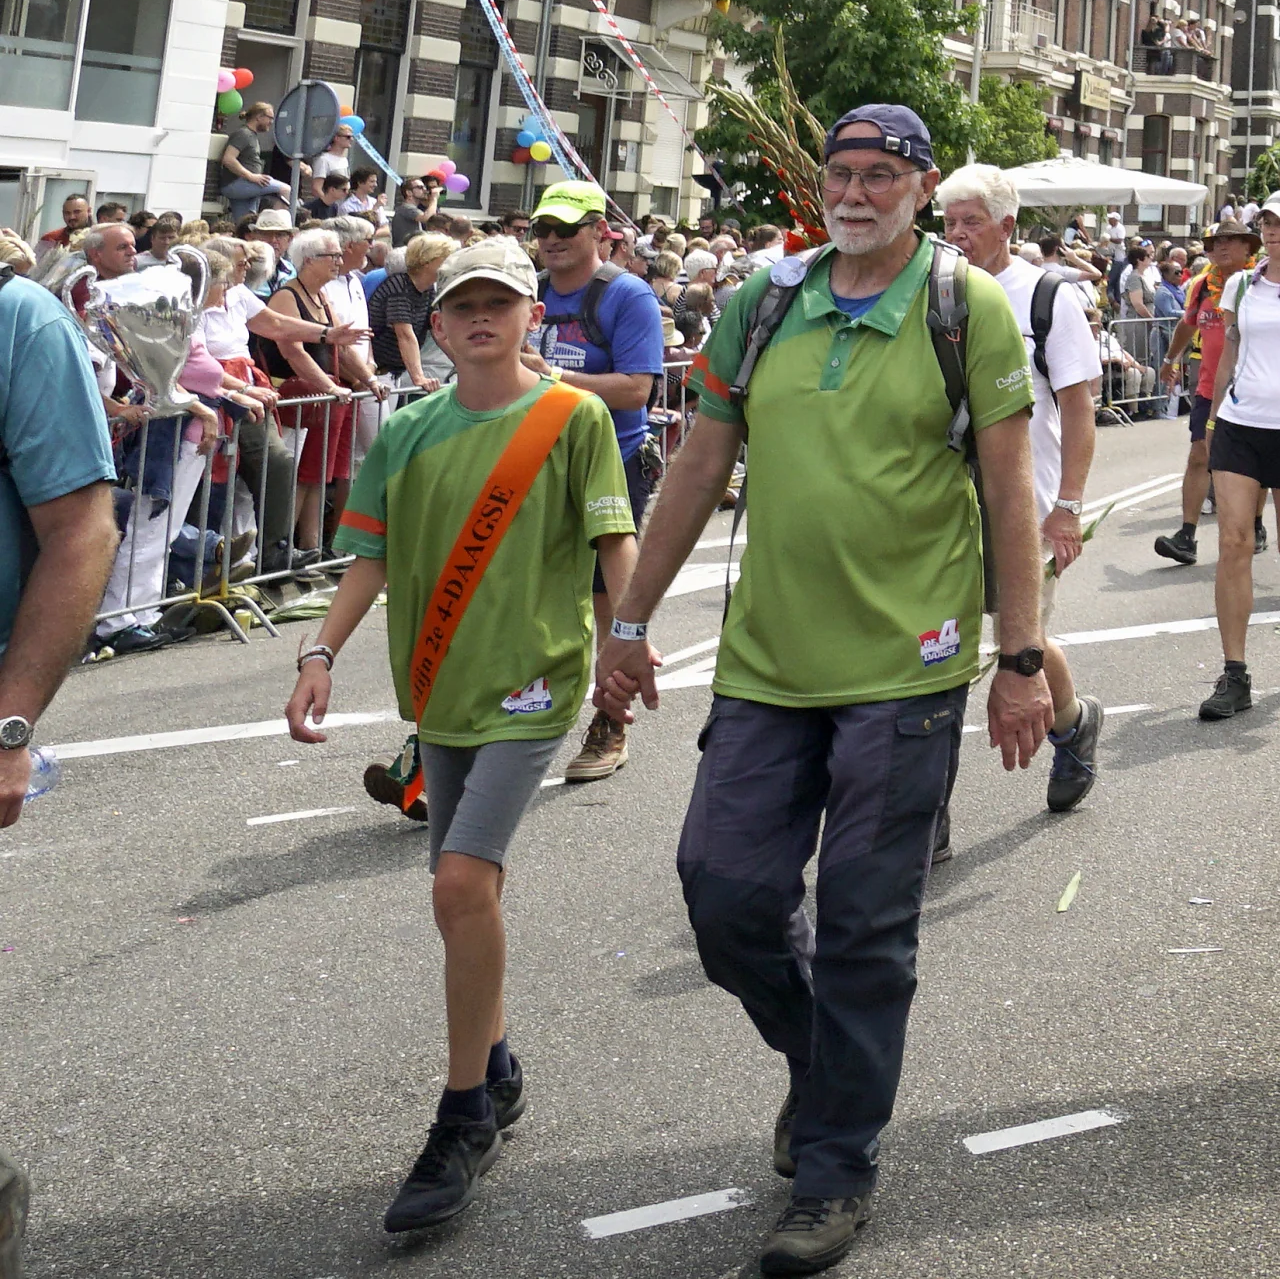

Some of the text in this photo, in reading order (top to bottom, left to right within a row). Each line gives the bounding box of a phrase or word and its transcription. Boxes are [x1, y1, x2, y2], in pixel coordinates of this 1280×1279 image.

[559, 359, 585, 368] WORLD
[425, 626, 445, 654] 2e
[437, 484, 516, 623] 4-DAAGSE
[939, 618, 958, 646] 4
[924, 645, 957, 661] DAAGSE
